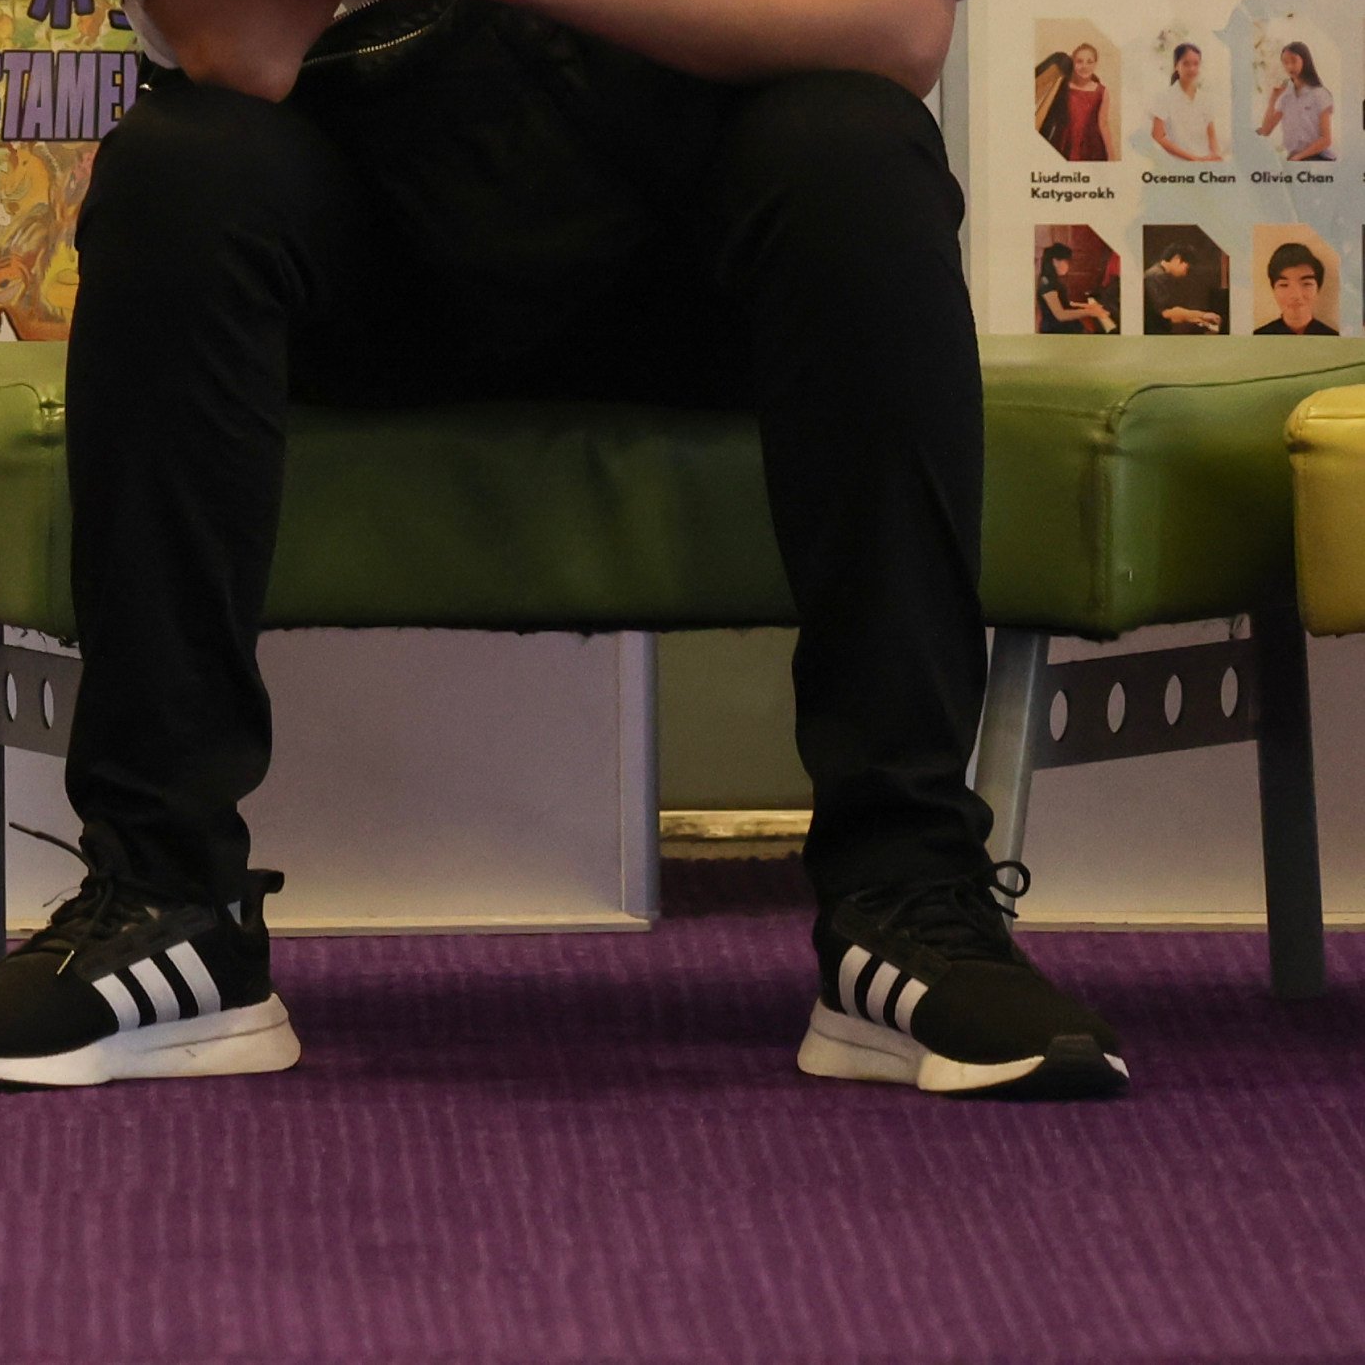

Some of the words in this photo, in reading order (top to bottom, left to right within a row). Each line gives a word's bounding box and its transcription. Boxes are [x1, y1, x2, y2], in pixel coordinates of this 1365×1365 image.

[1031, 172, 1090, 183] Liudmila
[1141, 172, 1195, 184] Oceana
[1199, 171, 1236, 183] Chan
[1250, 171, 1293, 183] Olivia
[1296, 171, 1334, 183] Chan
[1031, 187, 1115, 202] Katygorokh
